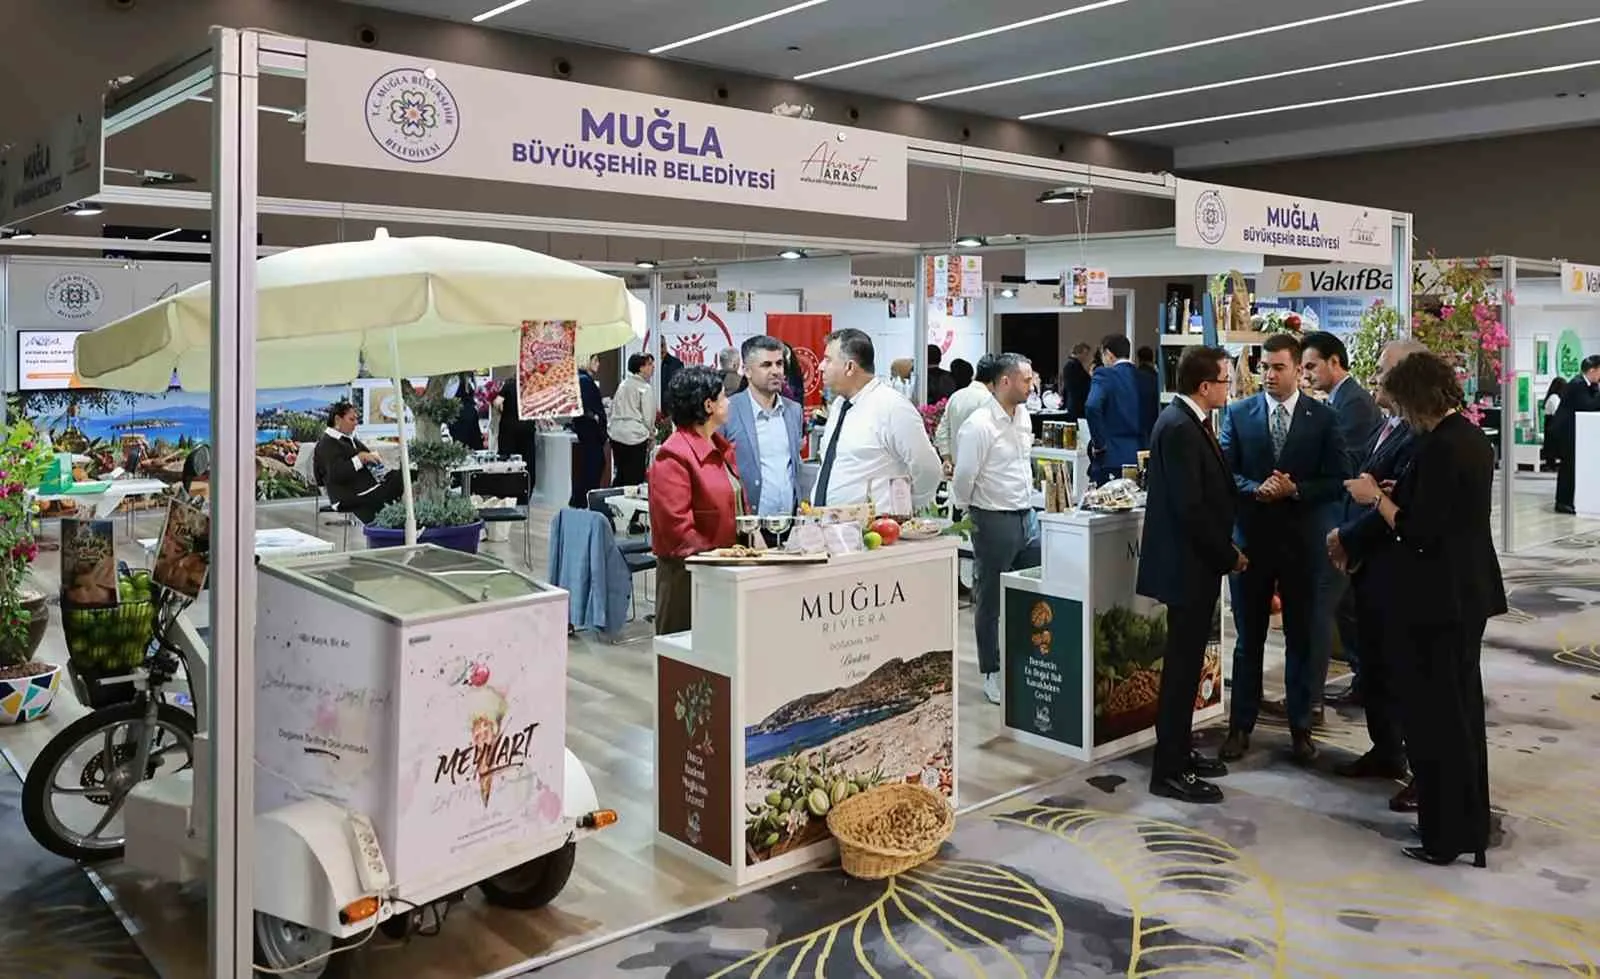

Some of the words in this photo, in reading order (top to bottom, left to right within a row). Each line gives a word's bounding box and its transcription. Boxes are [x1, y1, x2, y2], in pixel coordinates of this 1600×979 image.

[581, 107, 724, 159] MUĞLA
[512, 140, 657, 177] BÜYÜKŞEHİR
[663, 163, 776, 190] BELEDİYESİ
[800, 141, 878, 180] Ahmet
[823, 168, 858, 182] ARAS
[1267, 203, 1319, 232] MUĞLA
[1243, 226, 1295, 247] BÜYÜKŞEHİR
[1296, 234, 1340, 249] BELEDİYESİ
[859, 278, 884, 288] Sosyal
[800, 580, 905, 621] MUĞLA
[822, 613, 886, 633] RIVIERA
[434, 722, 540, 786] MEYVART
